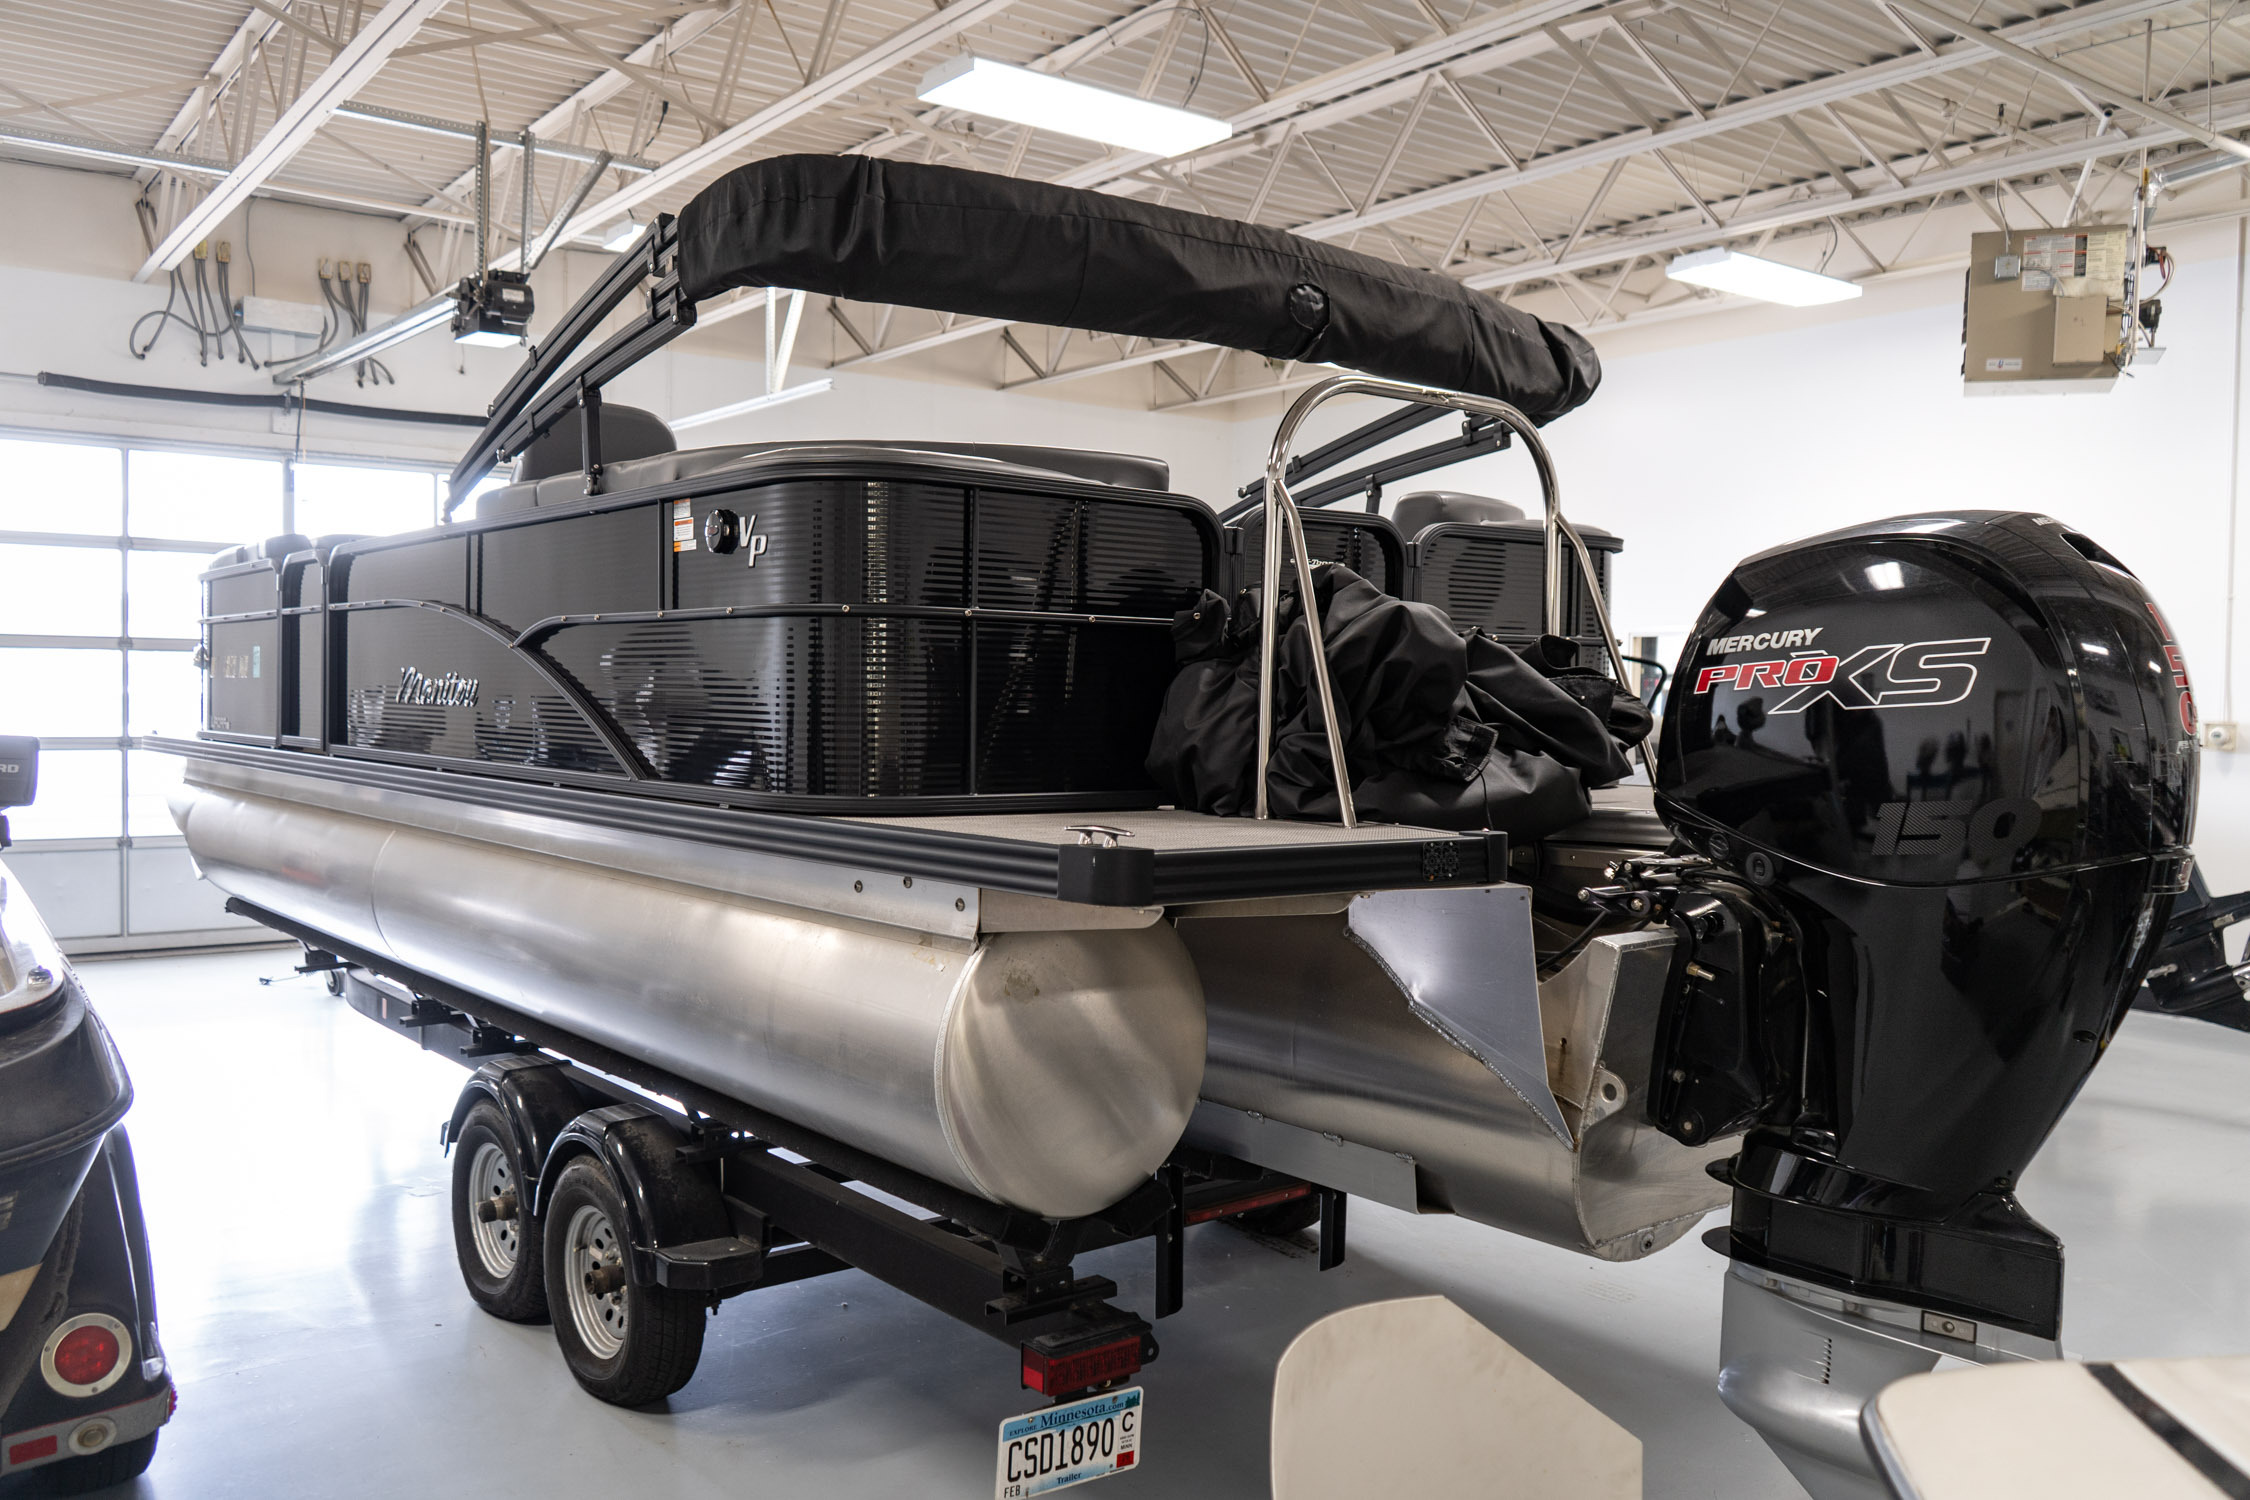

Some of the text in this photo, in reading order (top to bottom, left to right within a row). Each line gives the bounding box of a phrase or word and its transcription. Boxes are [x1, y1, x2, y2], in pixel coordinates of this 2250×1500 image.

[1706, 627, 1824, 656] MERCURY
[396, 666, 479, 708] Manitou
[1693, 637, 1991, 715] PRO XS
[1871, 799, 2043, 857] 150
[1009, 1402, 1125, 1437] EXPLORE Minnesota.com
[1007, 1411, 1135, 1483] CSD1890 C
[1004, 1484, 1021, 1498] FEB
[1057, 1472, 1082, 1484] Trailer
